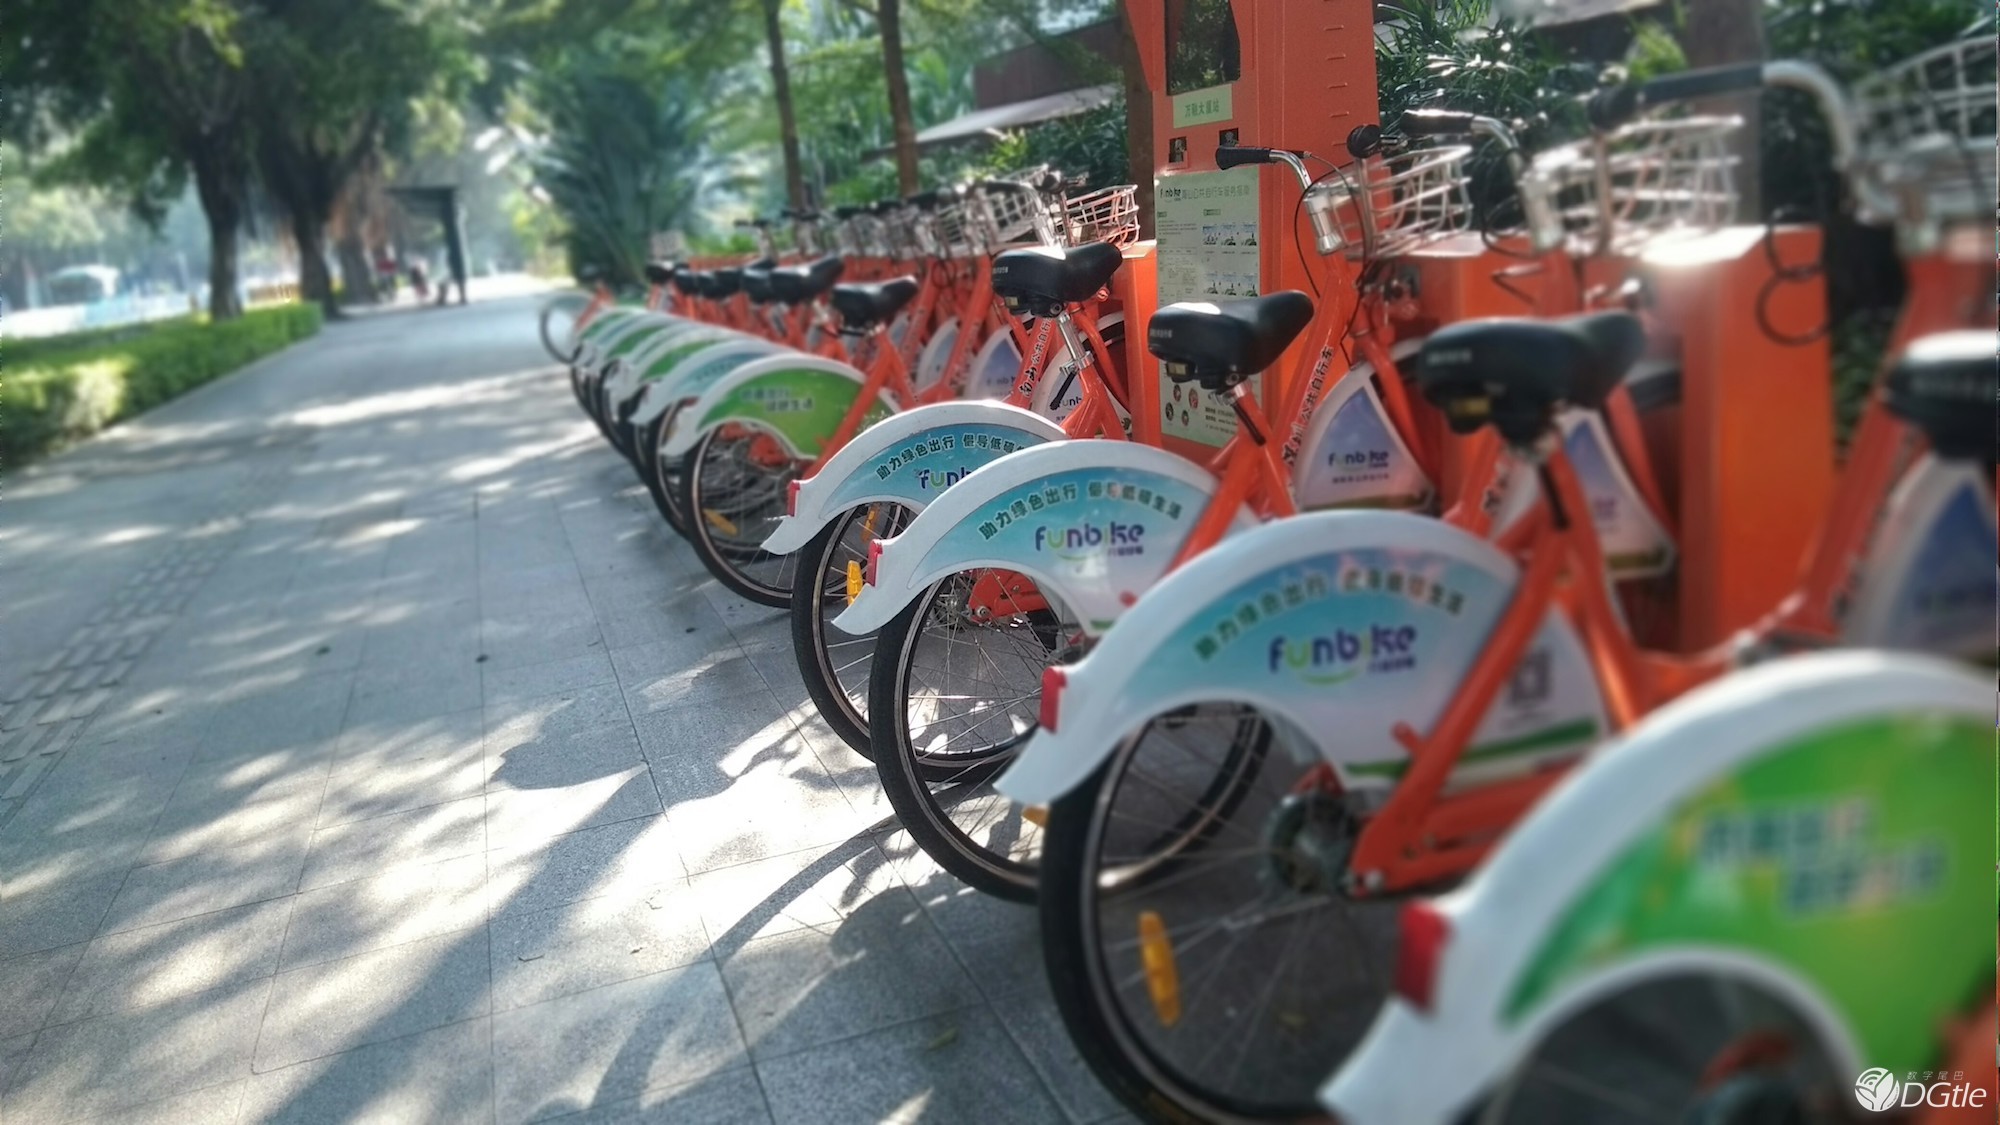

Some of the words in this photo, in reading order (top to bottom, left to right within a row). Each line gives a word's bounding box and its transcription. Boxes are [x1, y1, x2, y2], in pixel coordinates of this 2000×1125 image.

[876, 435, 955, 480] 助力绿色出行
[978, 482, 1078, 541] 助力绿色出行
[1035, 521, 1145, 552] funbike
[1268, 624, 1418, 673] funbike
